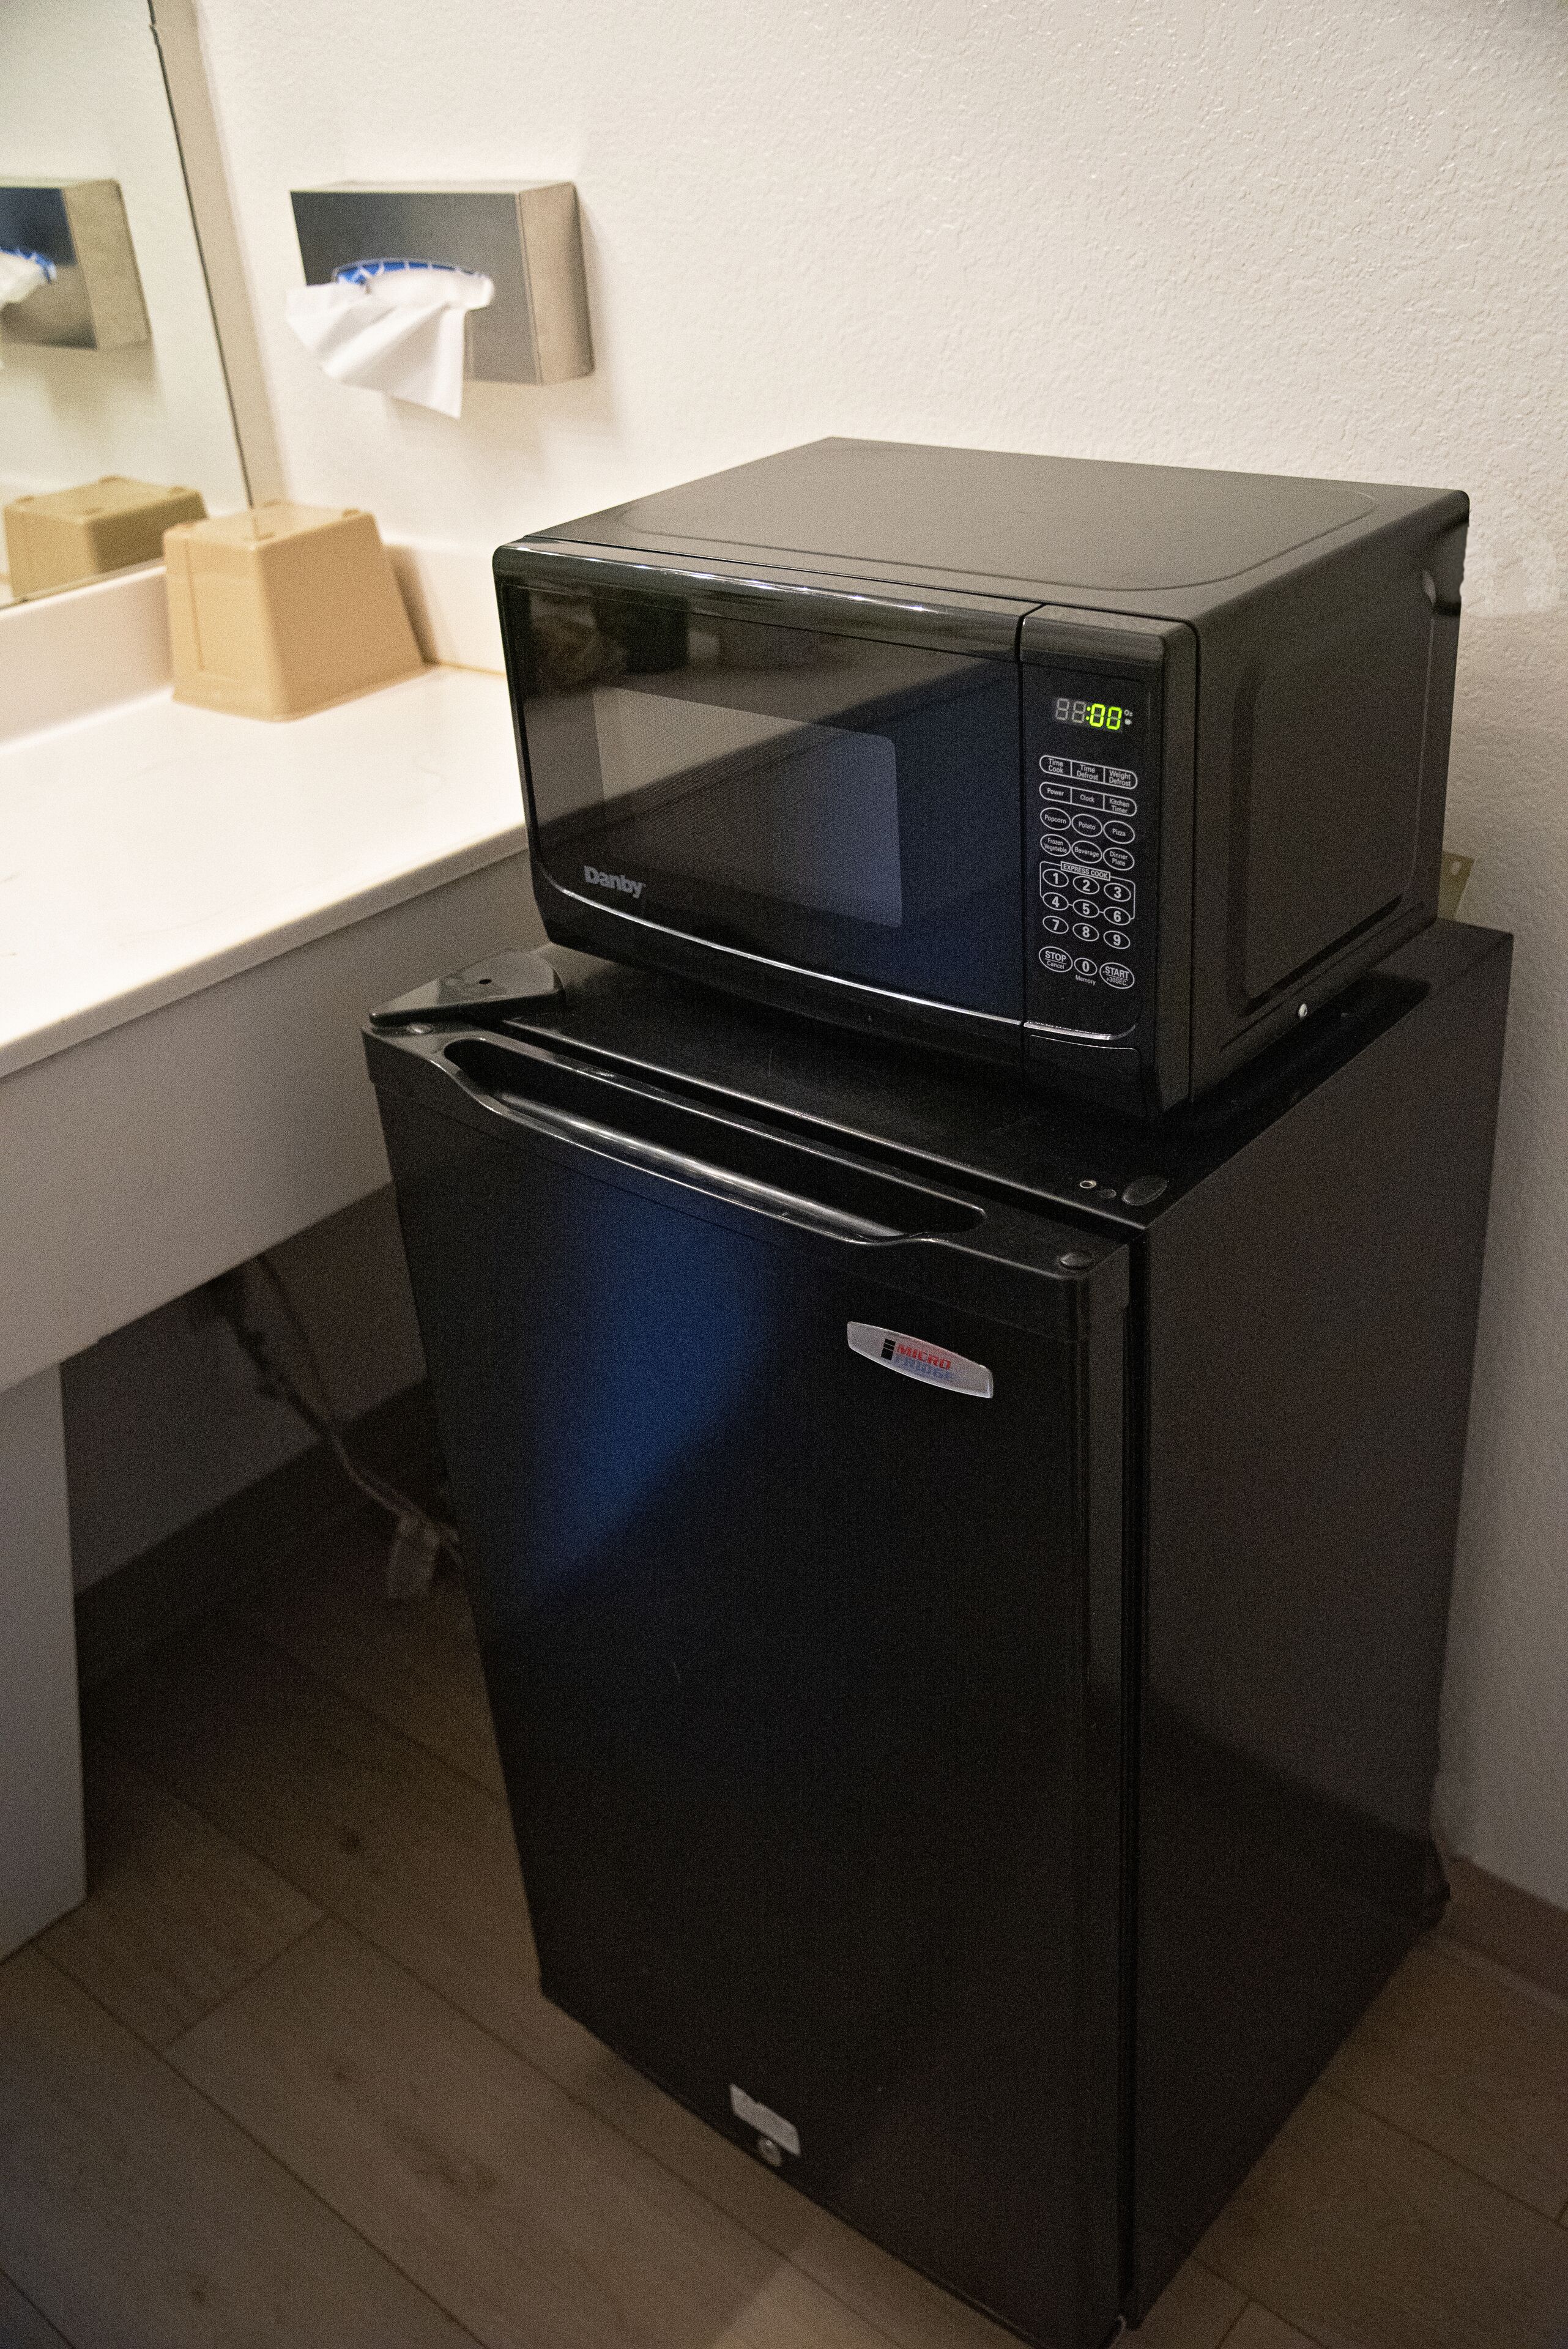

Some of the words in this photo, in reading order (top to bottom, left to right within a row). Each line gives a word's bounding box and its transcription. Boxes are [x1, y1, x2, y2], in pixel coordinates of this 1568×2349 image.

[1049, 758, 1063, 767] Time
[1048, 765, 1064, 774] Cook
[1080, 764, 1096, 773] Time
[1077, 770, 1099, 781] Defrost
[1109, 770, 1131, 781] Weight
[1109, 777, 1131, 787] Defrost
[1047, 787, 1064, 796] Power
[1080, 794, 1094, 803] Clock
[1109, 798, 1130, 807] Kitchen
[1111, 805, 1128, 814] Timer
[1044, 814, 1066, 824] Popcorn
[1079, 821, 1096, 830] Potato
[1112, 828, 1126, 837] Pizza
[1047, 837, 1064, 846] Frozen
[1044, 843, 1068, 853] Vegetable
[1074, 847, 1099, 858] Beverage
[1109, 851, 1128, 860] Dinner
[1112, 858, 1126, 866] Plate
[1063, 864, 1090, 875] EXPRESS
[1090, 870, 1108, 880] COOK
[584, 865, 645, 899] Danby
[1052, 873, 1059, 885] 1
[1082, 879, 1090, 892] 2
[1113, 886, 1121, 899] 3
[1052, 896, 1060, 908] 4
[1082, 903, 1090, 915] 5
[1113, 910, 1121, 922] 6
[1052, 919, 1060, 931] 7
[1082, 926, 1090, 938] 8
[1113, 934, 1121, 946] 9
[1045, 951, 1067, 962] STOP
[1047, 960, 1065, 970] Cancel
[1082, 960, 1090, 973] 0
[1105, 967, 1130, 979] START
[1075, 974, 1096, 986] Memory
[896, 1343, 951, 1370] MICRO
